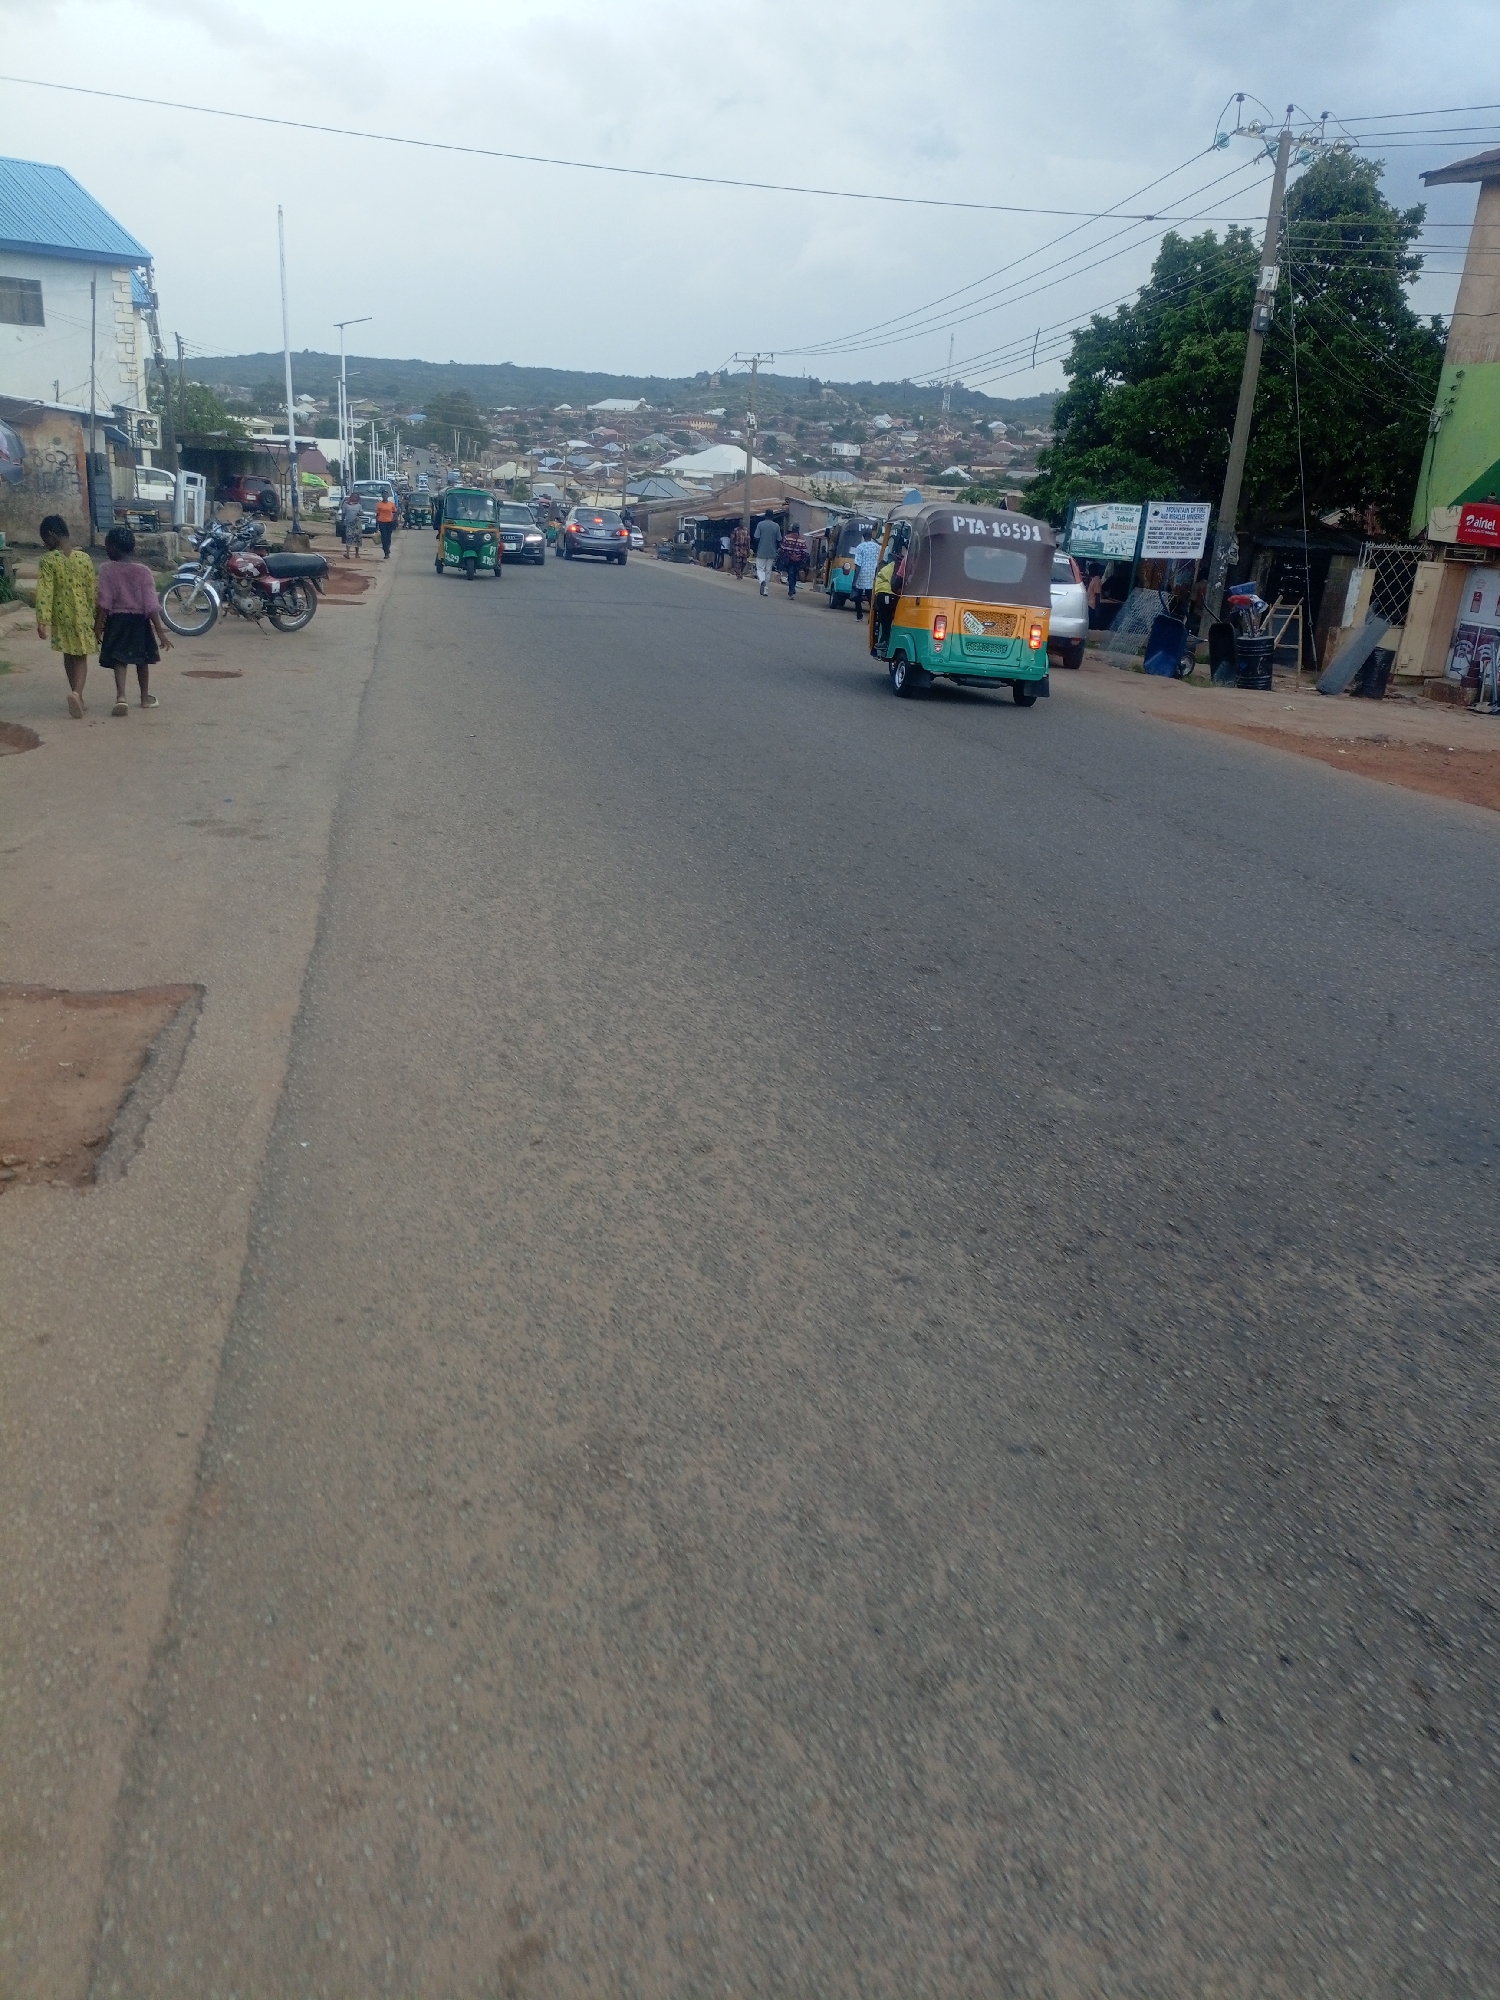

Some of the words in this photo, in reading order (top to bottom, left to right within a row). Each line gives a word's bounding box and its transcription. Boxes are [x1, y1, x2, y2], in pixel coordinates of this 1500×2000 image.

[953, 515, 1042, 541] PTA-10591
[1110, 523, 1137, 531] Admission
[1474, 517, 1496, 530] airtel
